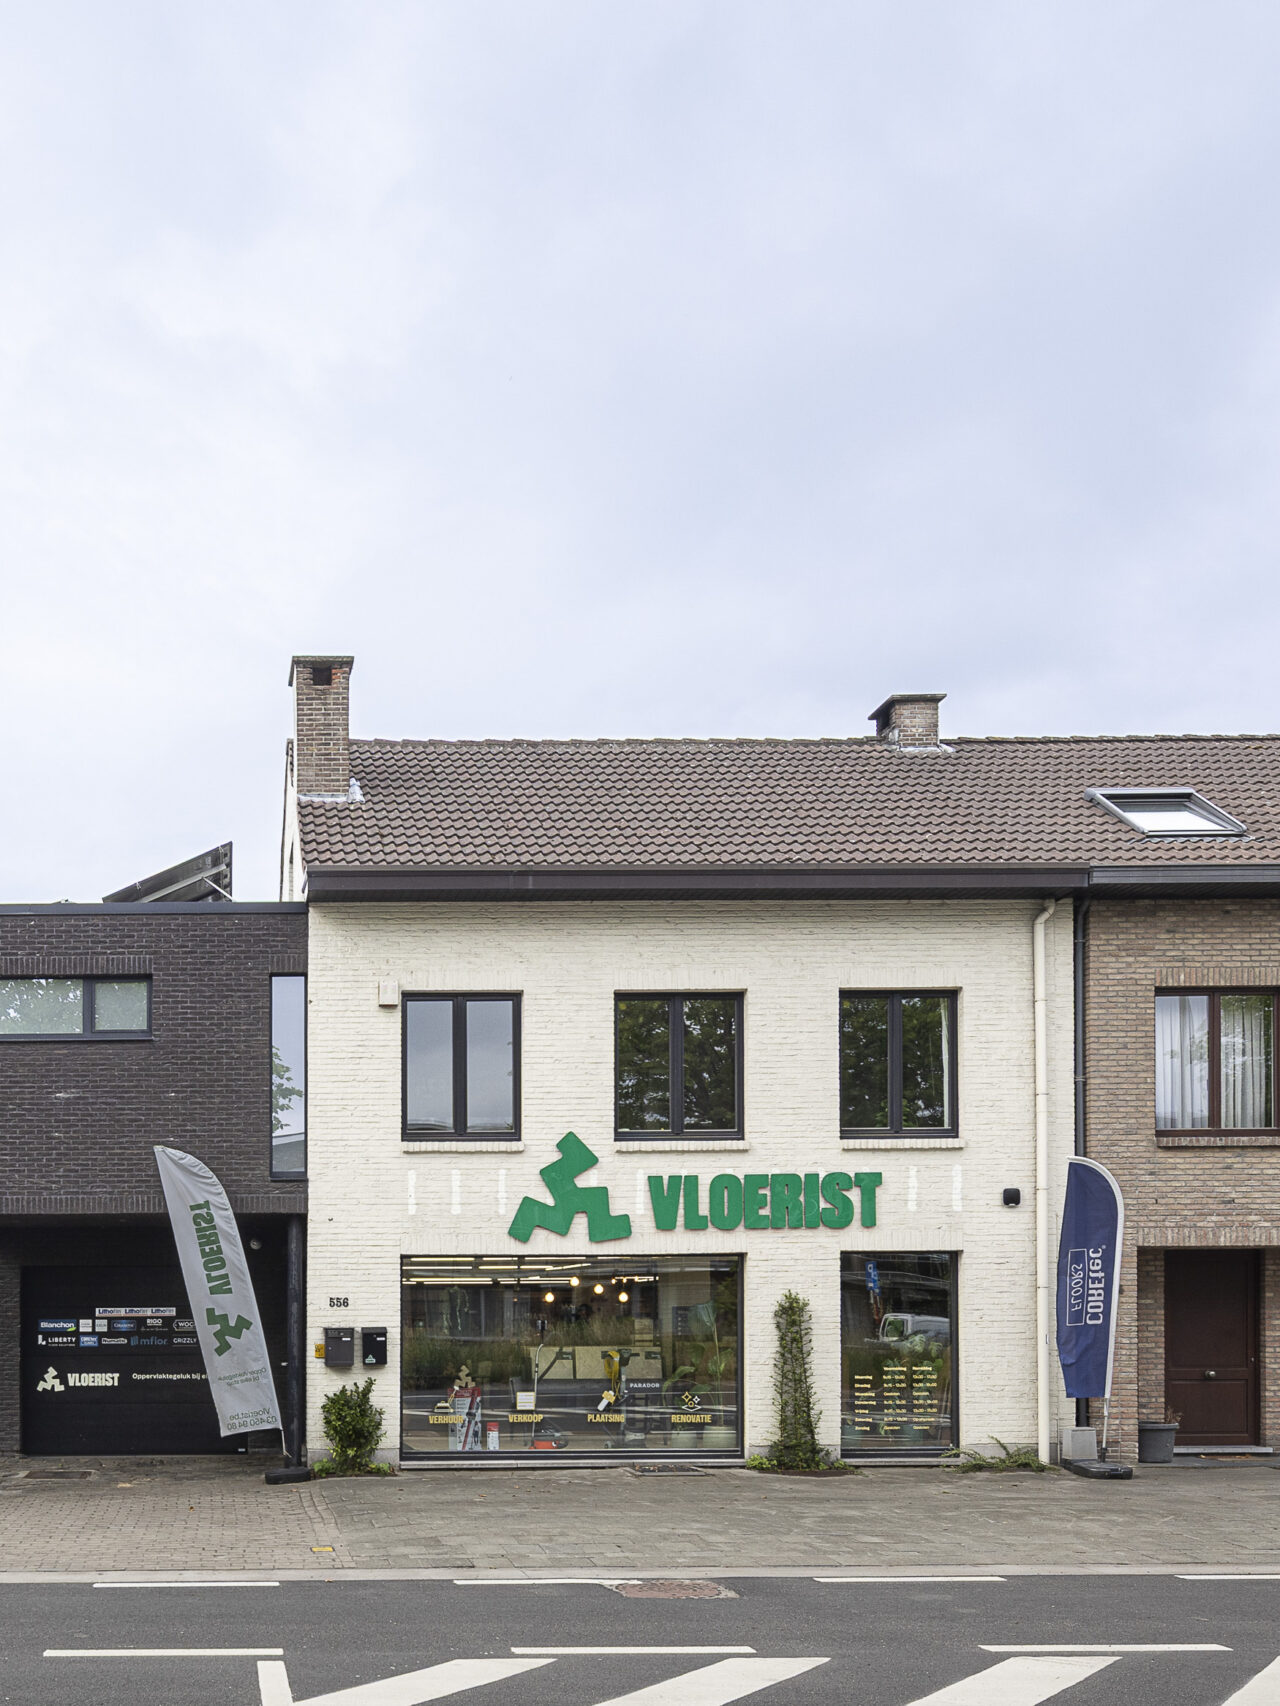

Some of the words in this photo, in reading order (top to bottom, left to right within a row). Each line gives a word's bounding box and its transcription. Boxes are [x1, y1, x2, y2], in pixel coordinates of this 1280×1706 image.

[648, 1172, 883, 1230] VLOERIST
[329, 1297, 349, 1307] 556
[67, 1373, 120, 1386] VLOERIST
[132, 1373, 190, 1381] Oppervlaktegeluk
[192, 1373, 201, 1381] bij
[428, 1415, 464, 1424] VERHUUR
[508, 1414, 543, 1423] VERKOOP
[587, 1413, 625, 1423] PLAATSING
[671, 1414, 712, 1423] RENOVATIE
